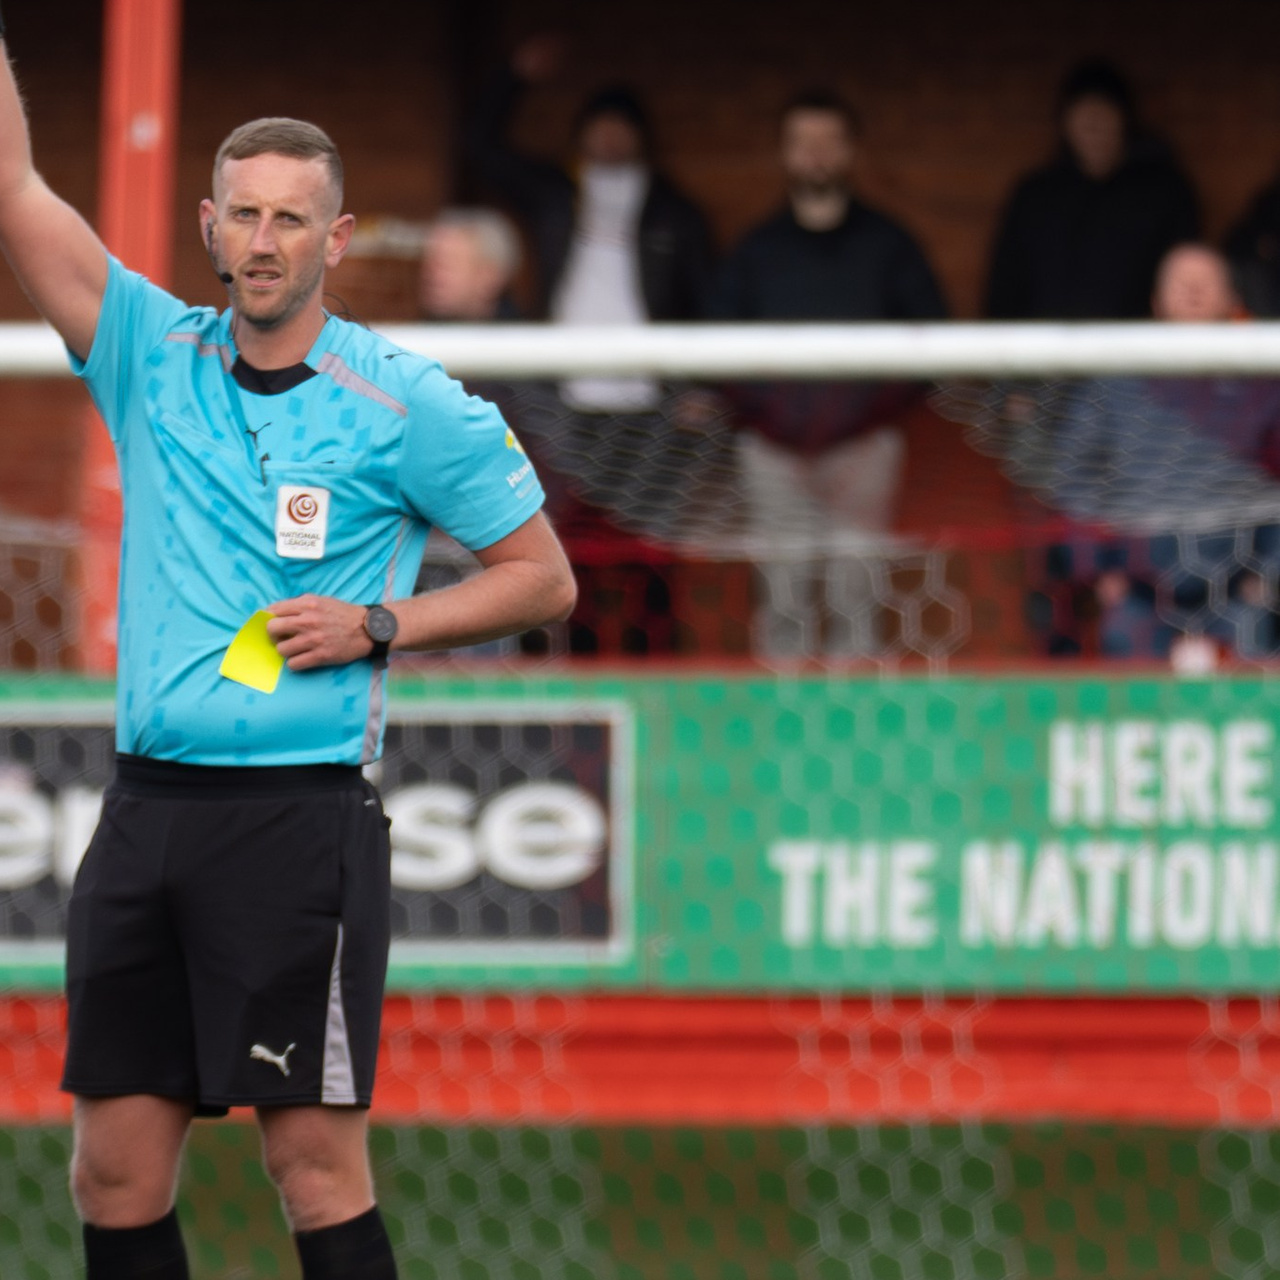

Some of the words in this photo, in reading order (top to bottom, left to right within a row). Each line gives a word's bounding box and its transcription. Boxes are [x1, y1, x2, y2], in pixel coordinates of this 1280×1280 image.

[1049, 720, 1272, 827] HERE
[766, 839, 939, 949] THE
[958, 839, 1278, 950] NATION
